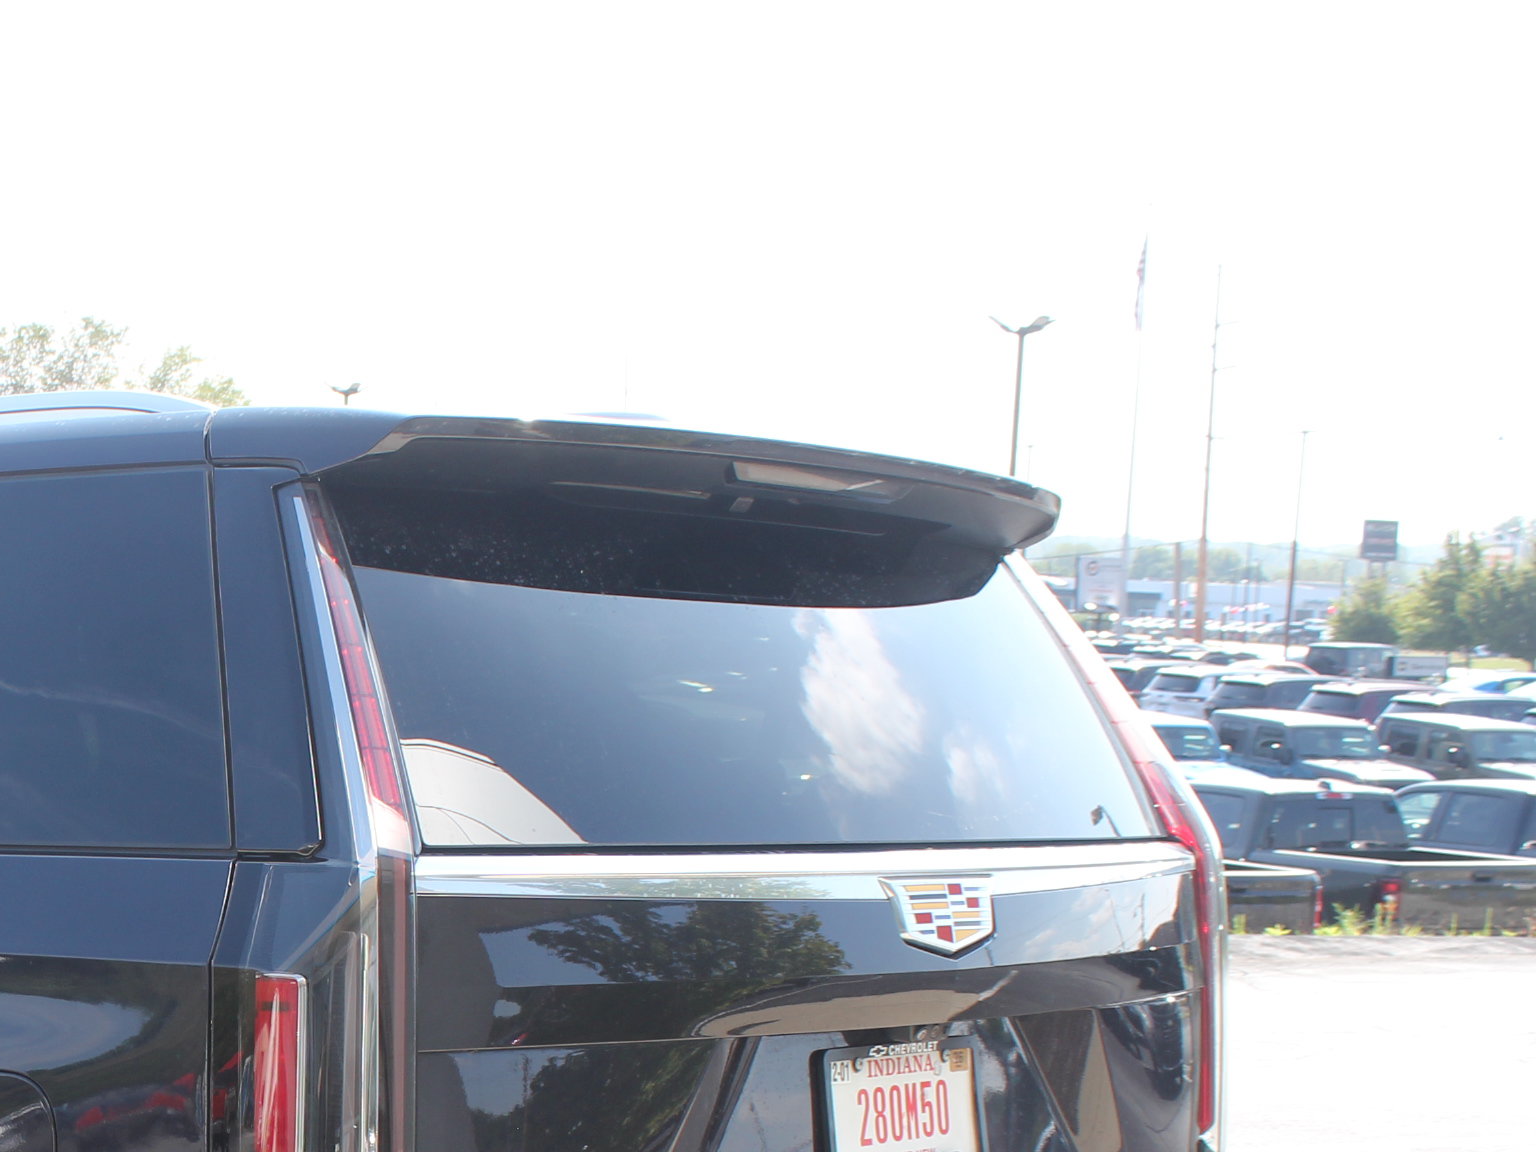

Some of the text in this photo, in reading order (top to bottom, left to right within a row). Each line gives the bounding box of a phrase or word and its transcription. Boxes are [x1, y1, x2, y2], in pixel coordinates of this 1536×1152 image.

[888, 1040, 938, 1055] CHEVROLET
[867, 1053, 936, 1078] INDIANA
[857, 1079, 951, 1147] 280M50
